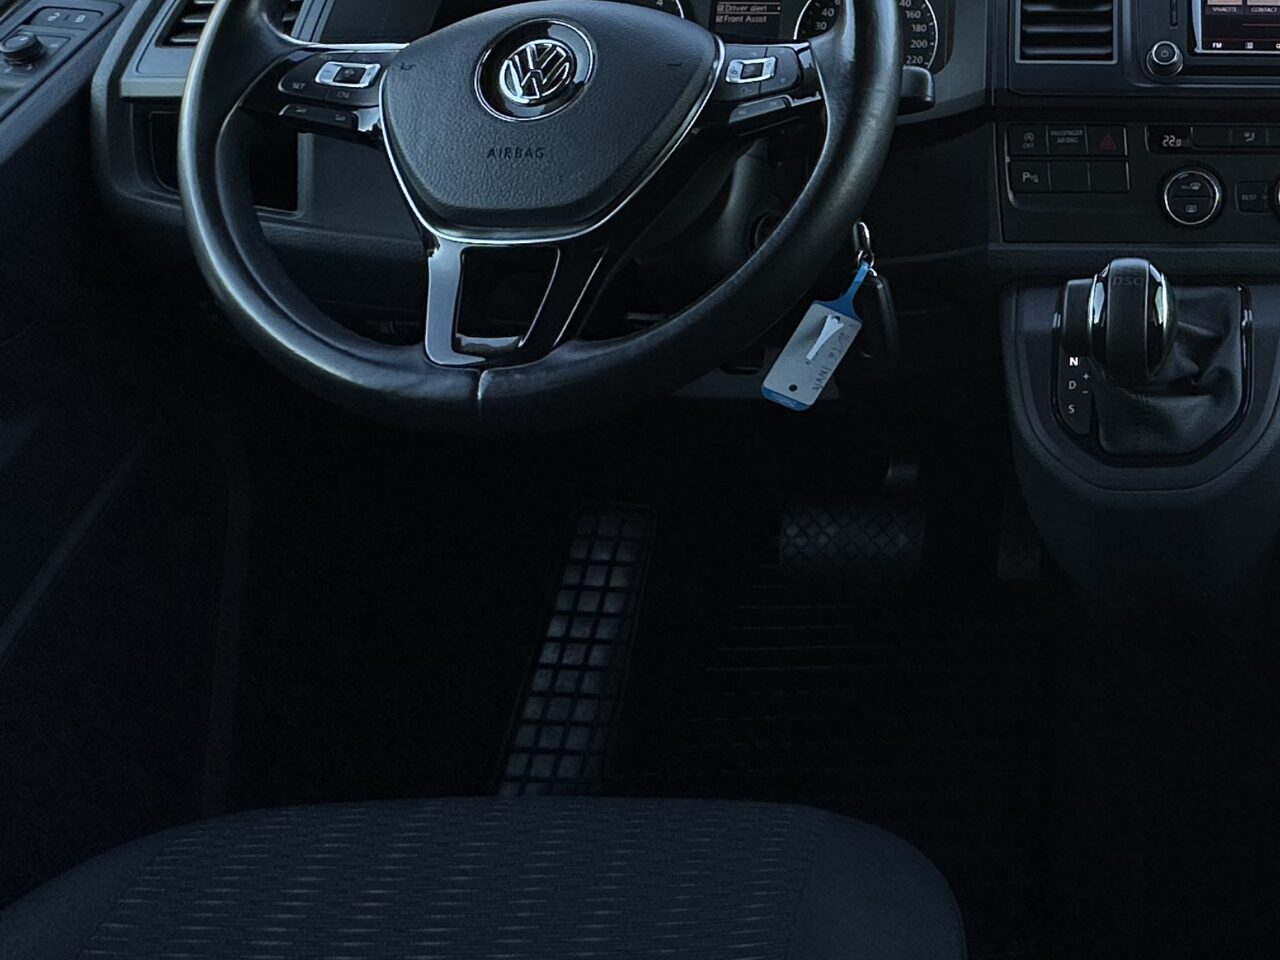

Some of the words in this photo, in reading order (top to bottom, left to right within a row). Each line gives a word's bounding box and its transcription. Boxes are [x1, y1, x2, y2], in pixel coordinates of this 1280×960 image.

[821, 8, 835, 17] 40
[905, 10, 921, 19] 160
[815, 22, 827, 30] 30
[911, 24, 927, 33] 180
[910, 40, 928, 48] 200
[906, 55, 923, 64] 220
[486, 146, 546, 160] AIRBAG
[1069, 357, 1079, 366] N
[1068, 381, 1077, 390] D
[1067, 404, 1076, 415] S
